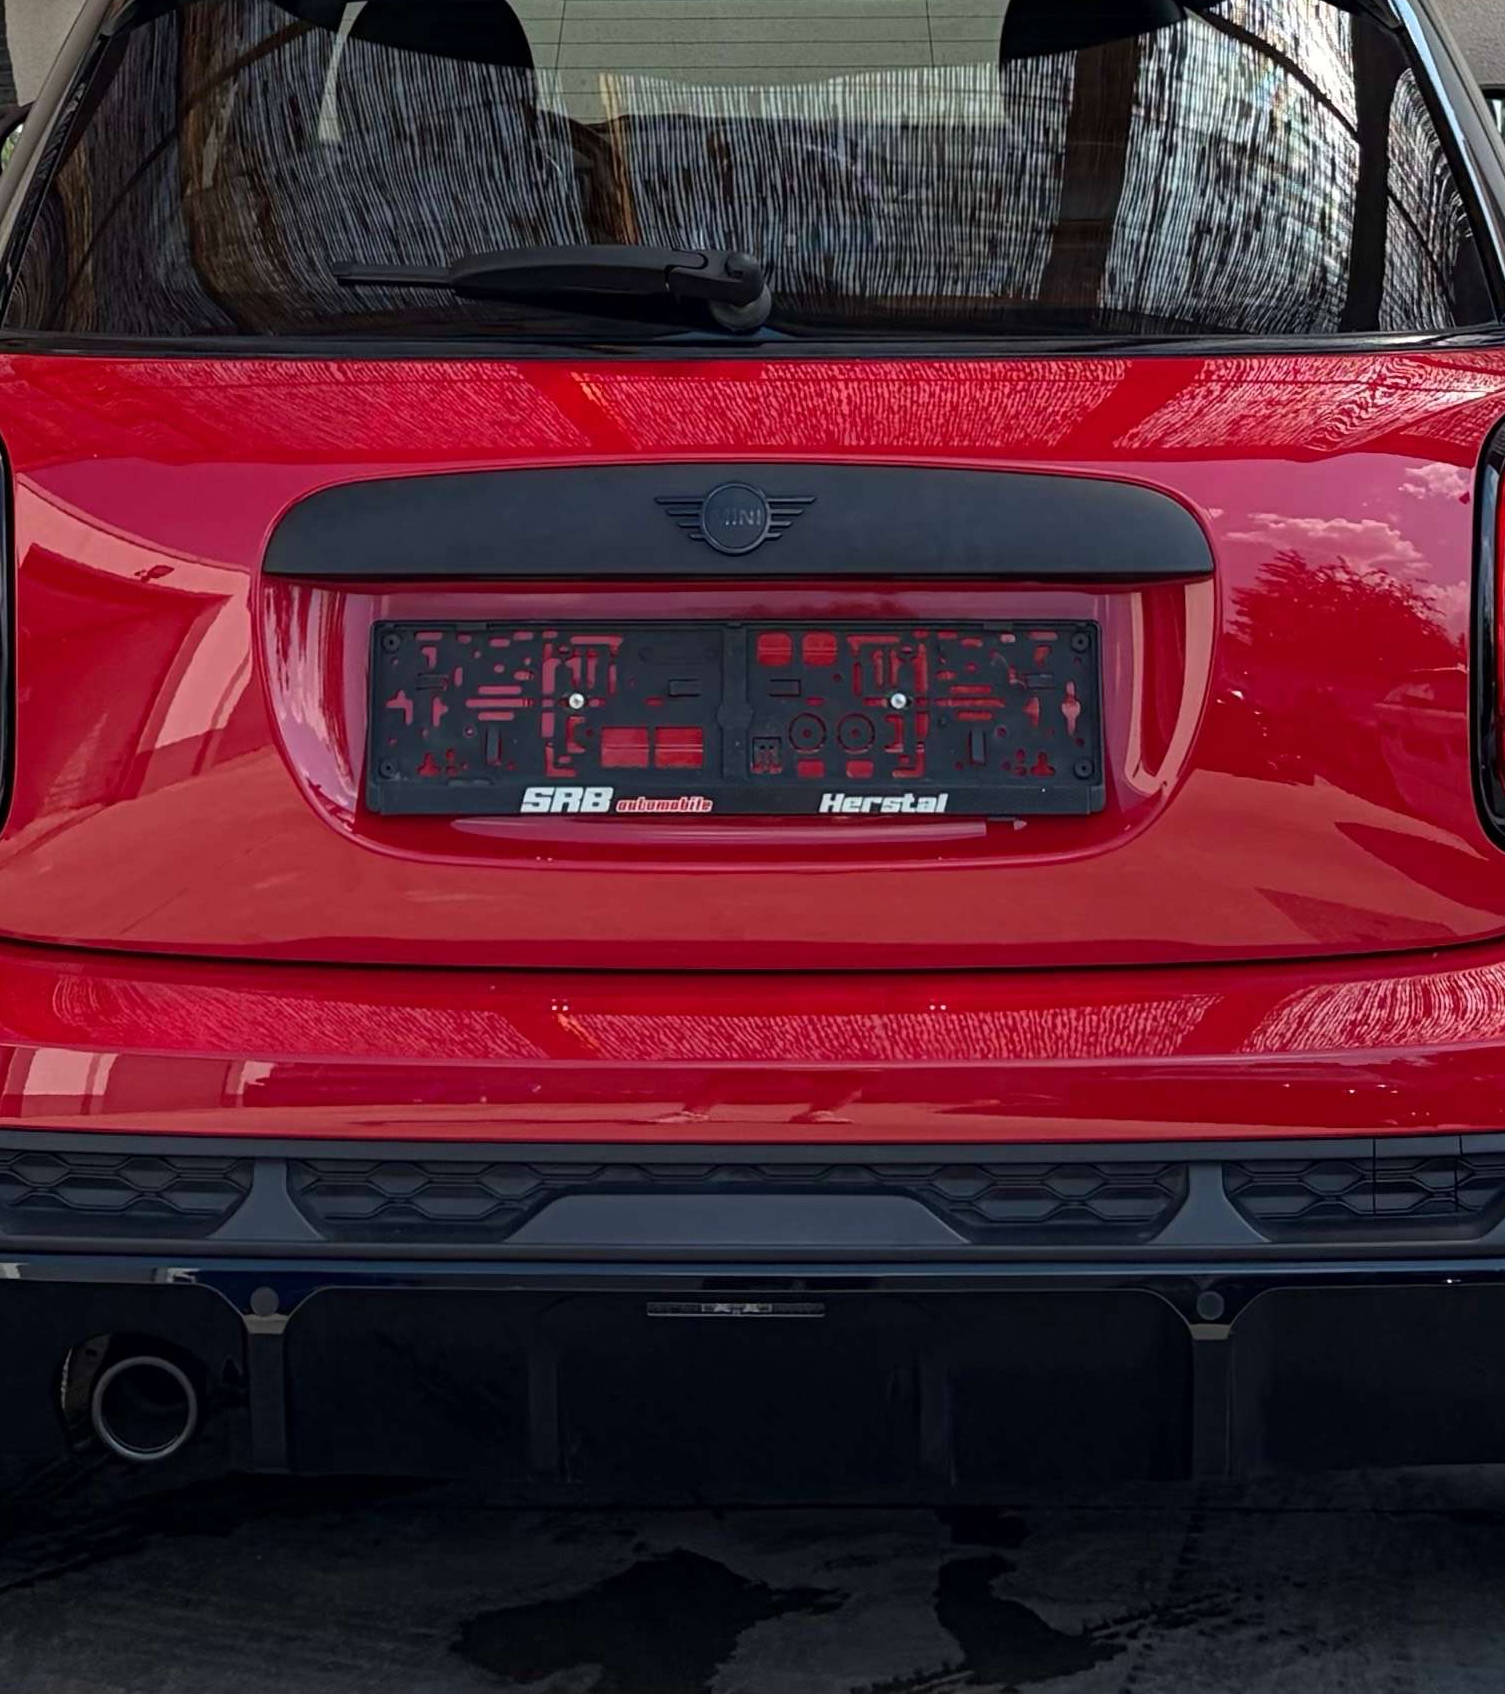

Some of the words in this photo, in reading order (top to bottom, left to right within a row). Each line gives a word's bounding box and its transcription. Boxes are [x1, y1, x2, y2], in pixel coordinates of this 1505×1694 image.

[520, 787, 614, 813] SRB
[615, 796, 714, 813] automobile
[818, 792, 949, 813] Herstal
